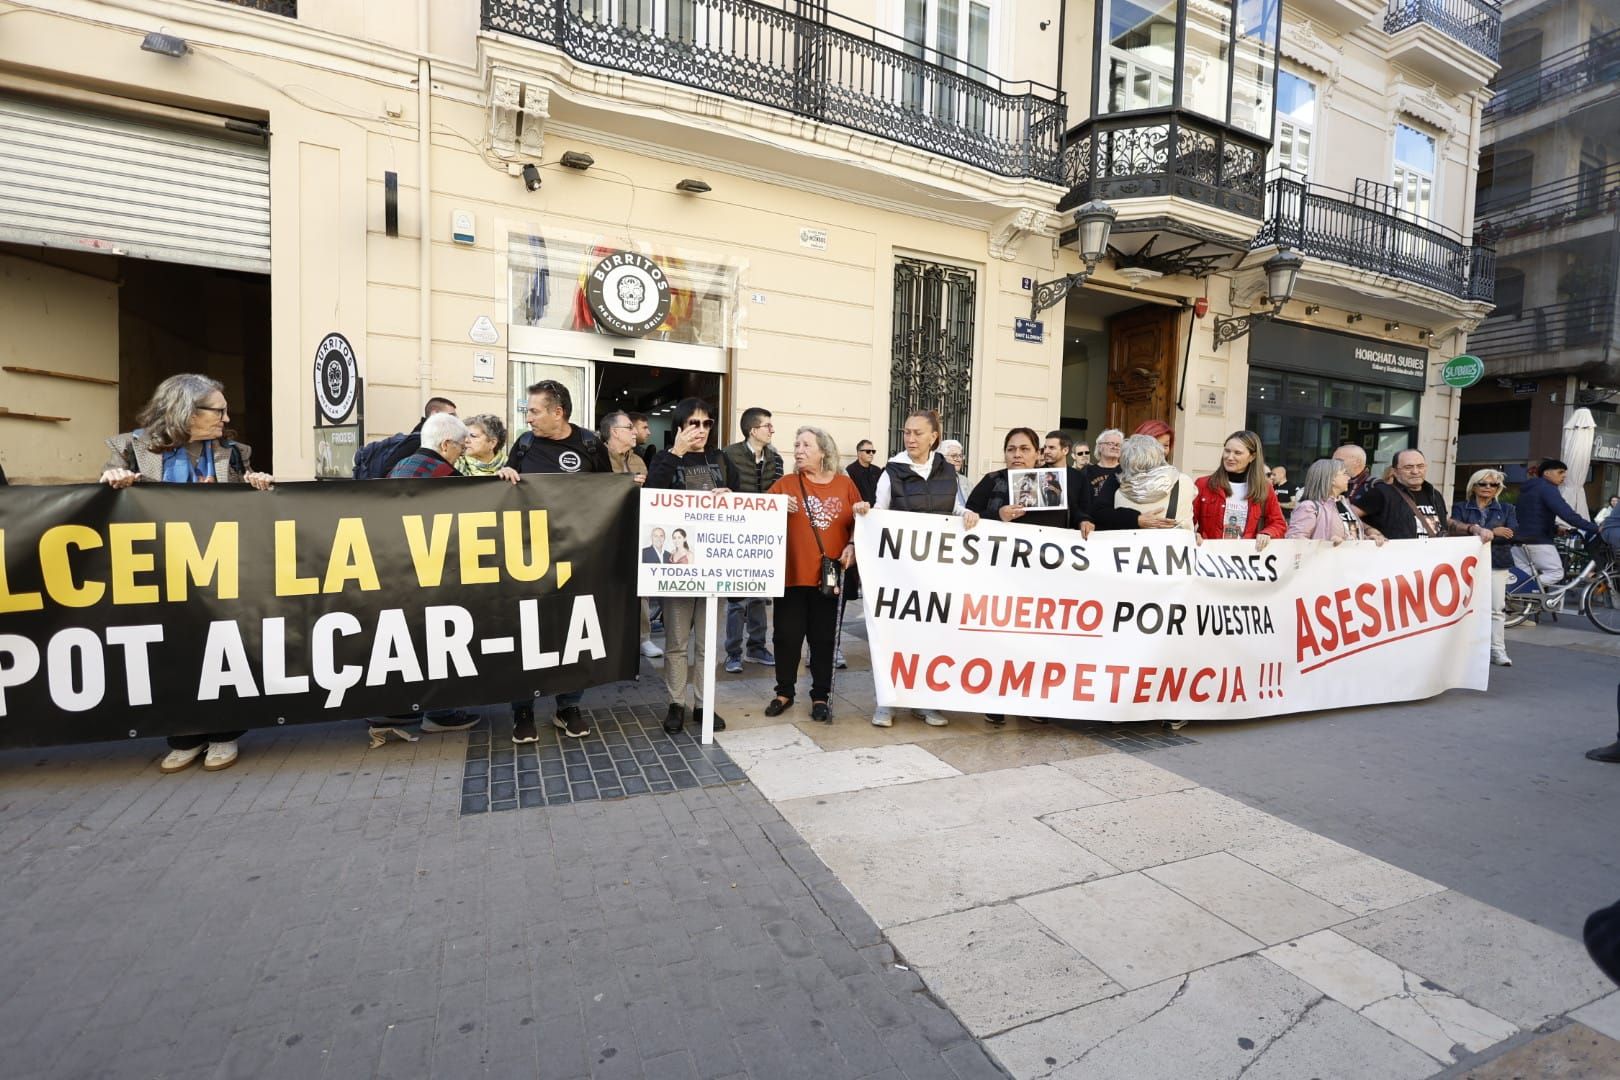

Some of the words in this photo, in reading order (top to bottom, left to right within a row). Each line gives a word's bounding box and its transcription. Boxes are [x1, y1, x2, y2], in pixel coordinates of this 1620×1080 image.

[594, 254, 668, 290] BURRITOS
[597, 305, 633, 331] MEXICAN
[644, 311, 664, 329] GRILL
[316, 338, 353, 371] BURRITOS
[1354, 347, 1397, 366] HORCHATA
[1397, 355, 1424, 370] SUBIES
[650, 493, 728, 509] JUSTICIA
[733, 497, 778, 511] PARA
[684, 512, 715, 521] PADRE
[718, 513, 724, 522] E
[726, 514, 746, 523] HIJA
[696, 532, 735, 544] MIGUEL
[737, 533, 775, 545] CARPIO
[776, 535, 783, 545] Y
[0, 521, 239, 613] LCEM
[274, 517, 381, 597] LA
[402, 509, 572, 589] VEU,
[706, 547, 734, 559] SARA
[736, 548, 774, 559] CARPIO
[878, 527, 1090, 572] NUESTROS
[1113, 546, 1278, 582] FAMILIARES
[650, 567, 658, 576] Y
[661, 567, 698, 577] TODAS
[701, 568, 723, 577] LAS
[725, 568, 775, 578] VICTIMAS
[658, 578, 706, 591] MAZÓN
[716, 579, 767, 592] PRISIÓN
[874, 587, 952, 624] HAN
[960, 596, 1104, 631] MUERTO
[1112, 601, 1187, 636] POR
[1197, 604, 1275, 636] VUESTRA
[1296, 555, 1478, 664] ASESINOS
[0, 624, 164, 717] POT
[197, 594, 607, 708] ALÇAR-LA
